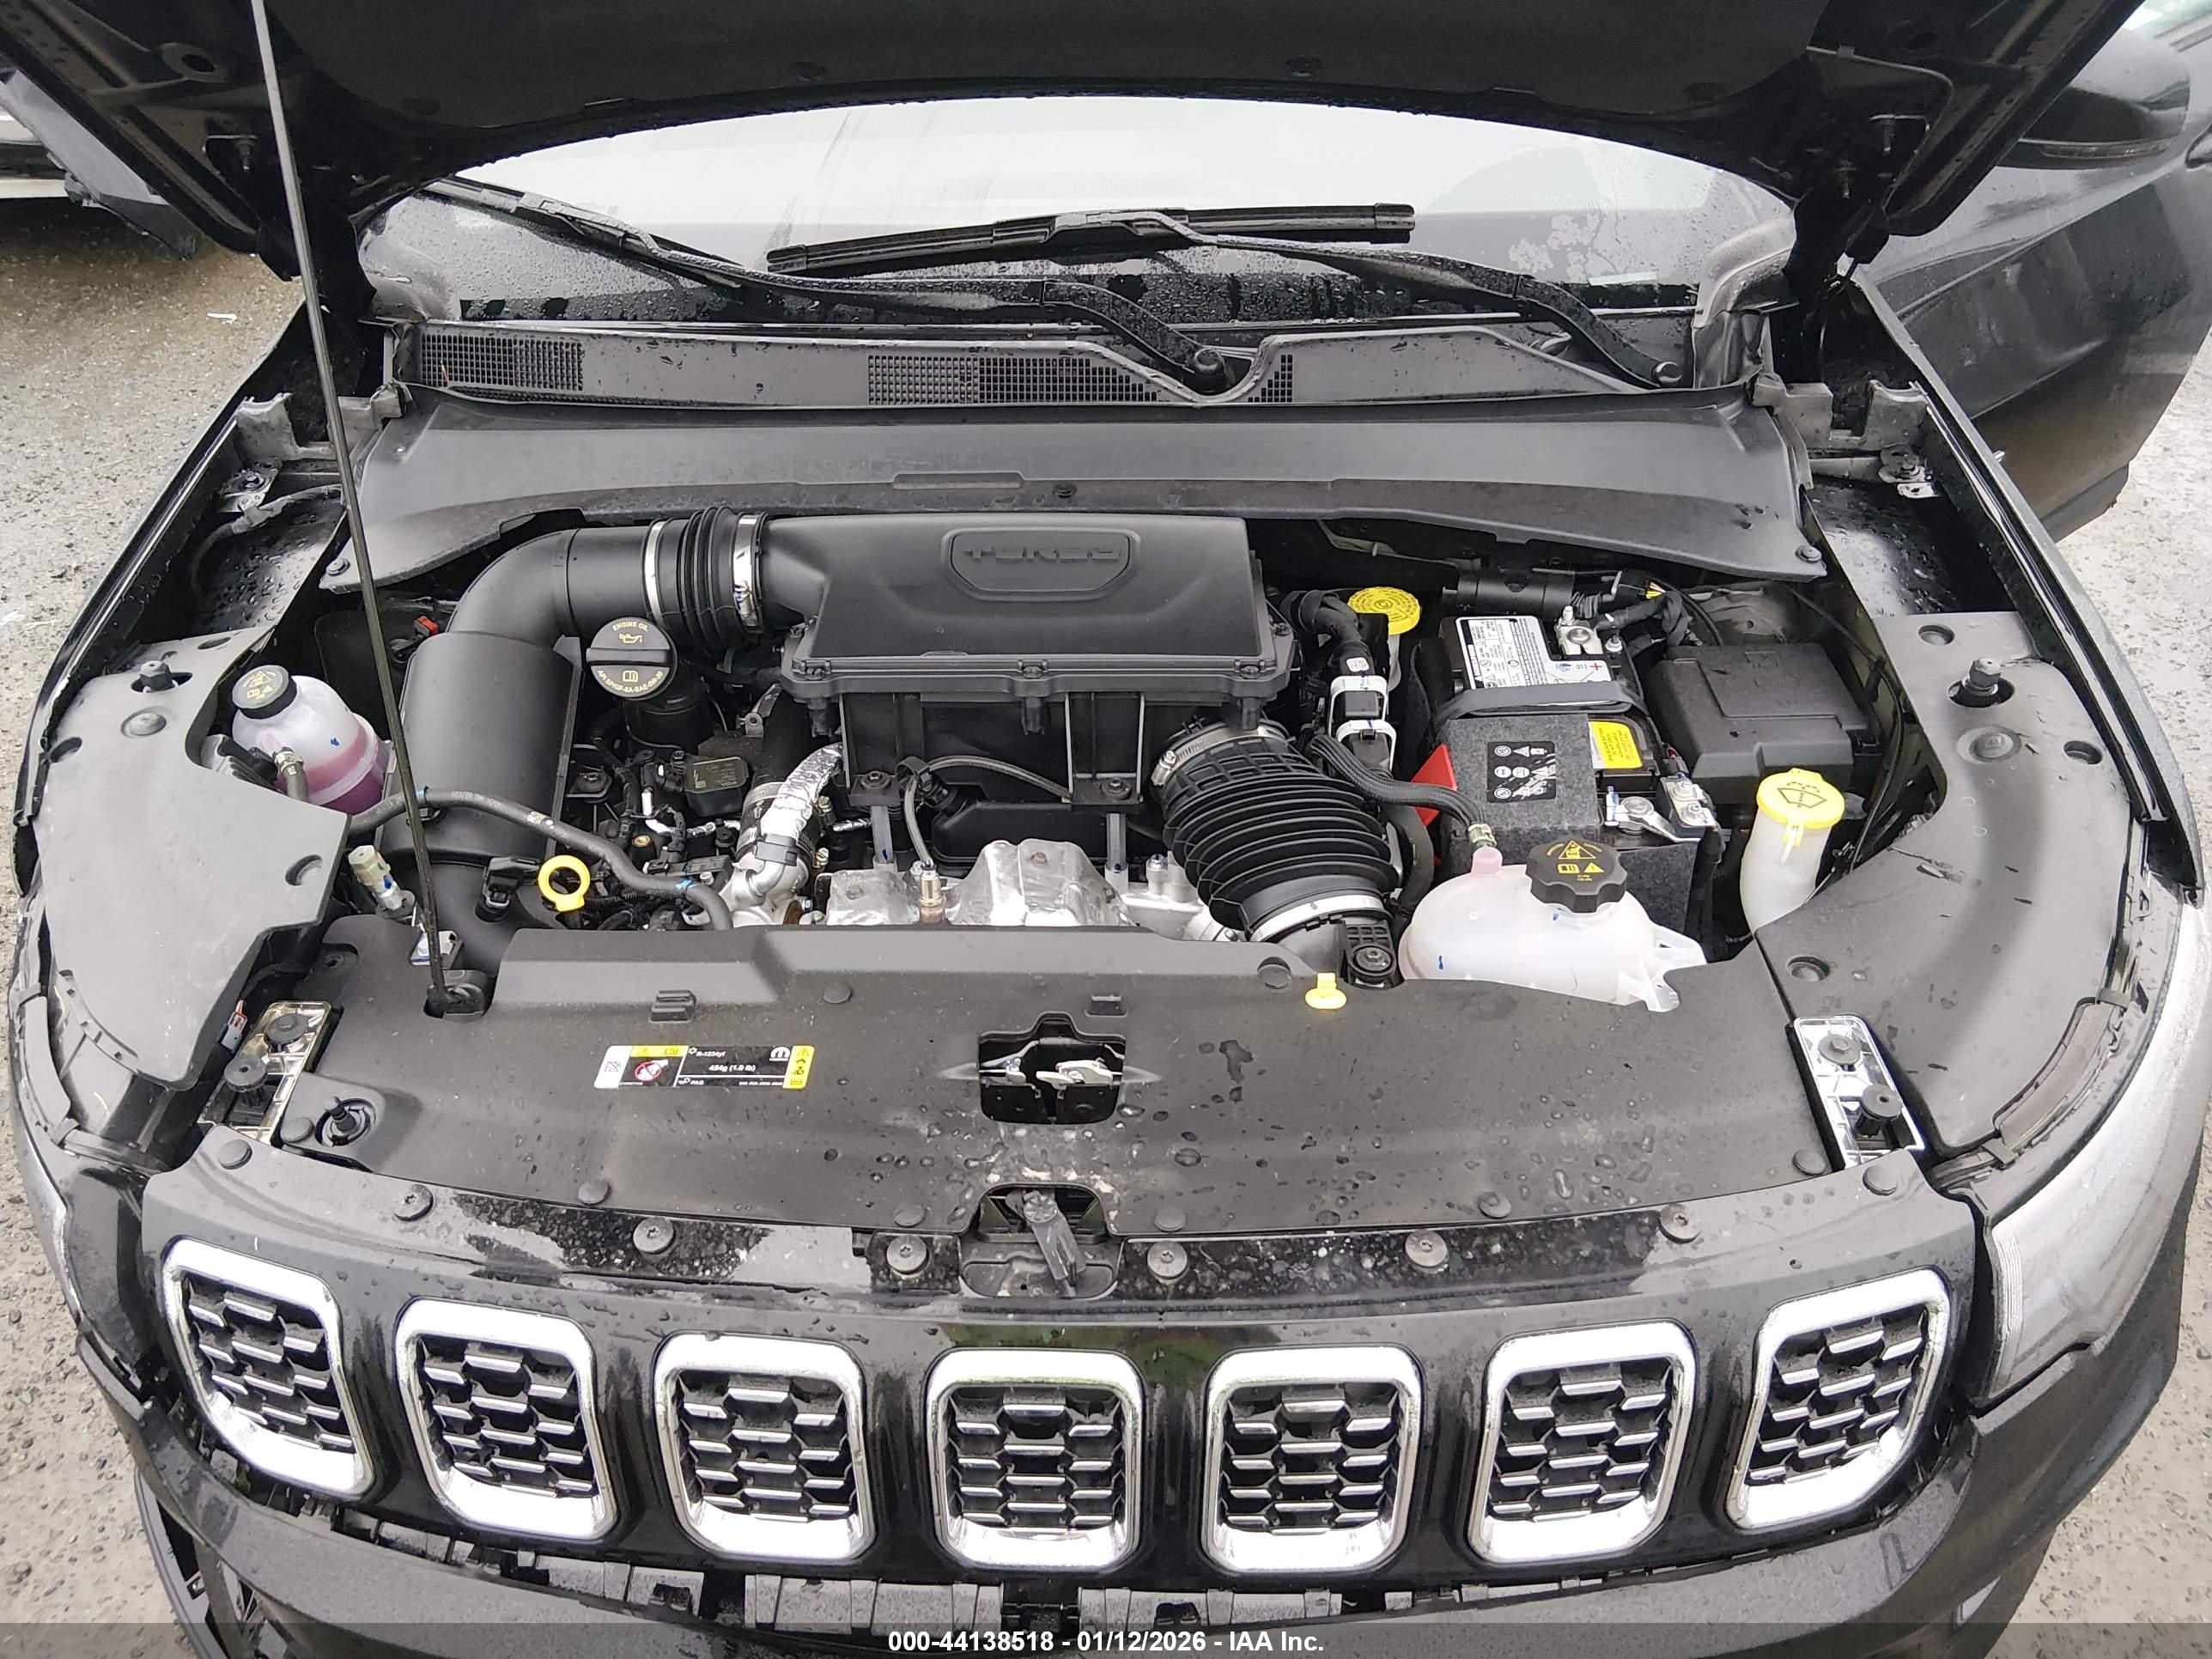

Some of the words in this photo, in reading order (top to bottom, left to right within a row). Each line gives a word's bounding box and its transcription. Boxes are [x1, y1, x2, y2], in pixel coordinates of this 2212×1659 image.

[962, 546, 1121, 564] TURBO
[612, 621, 637, 631] ENGINE
[638, 623, 648, 632] OIL
[598, 670, 607, 681] API
[744, 1064, 757, 1073] lb)
